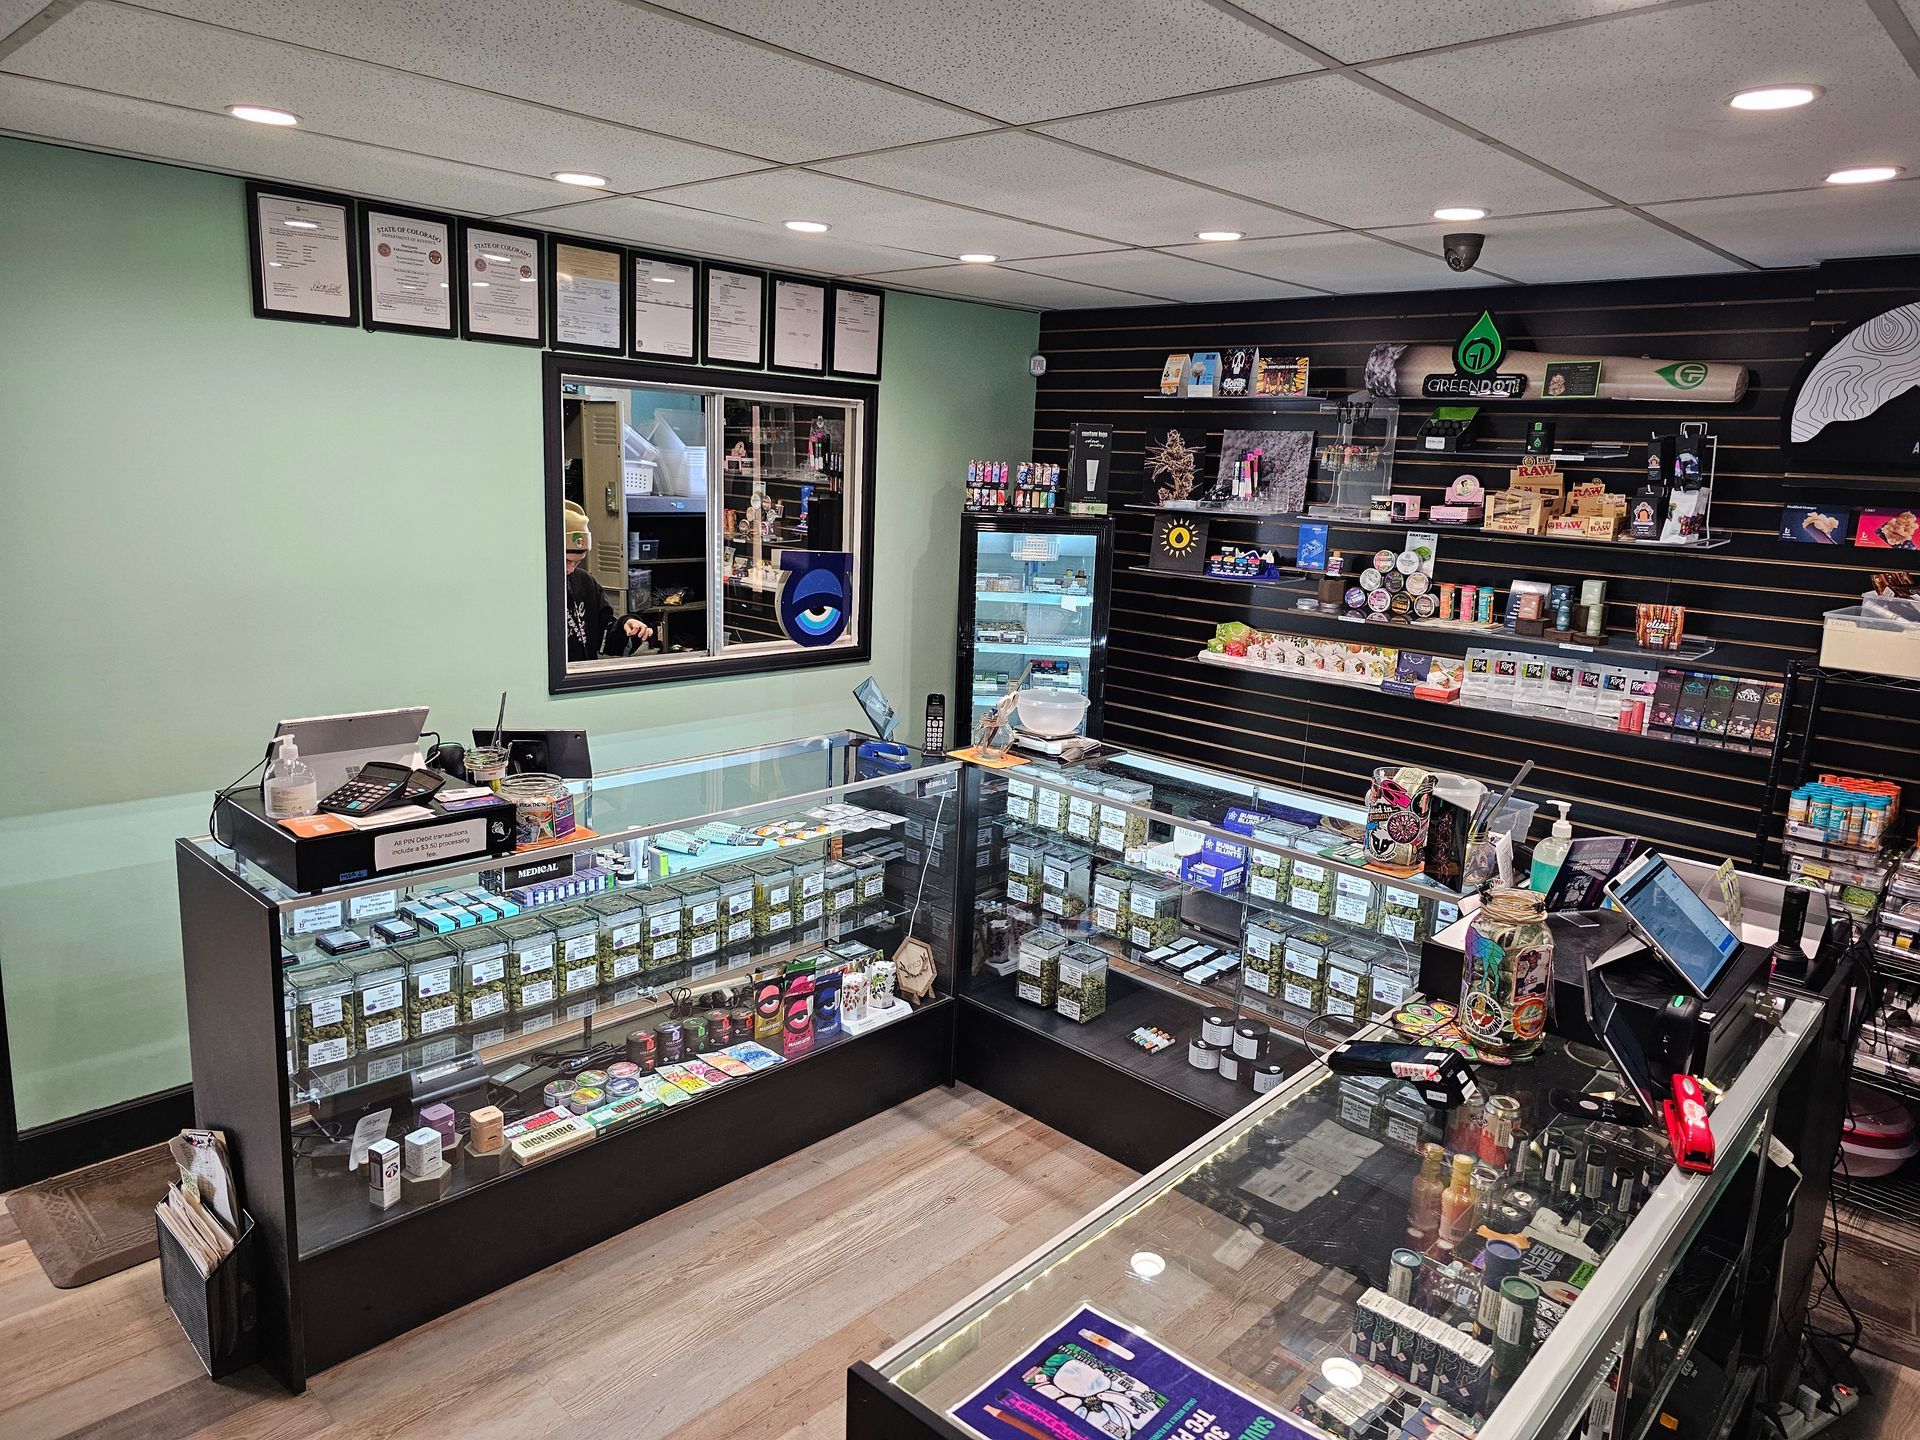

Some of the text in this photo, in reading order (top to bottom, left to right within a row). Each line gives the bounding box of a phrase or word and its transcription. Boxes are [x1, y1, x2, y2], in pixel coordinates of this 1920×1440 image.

[377, 226, 396, 234] STATE
[406, 228, 441, 243] COLORADO
[500, 244, 532, 258] COLORADO
[1518, 464, 1554, 477] RAW
[1573, 486, 1603, 498] RAW
[1555, 520, 1583, 530] RAW
[1590, 524, 1611, 532] RAW
[416, 835, 432, 843] Debit
[433, 830, 469, 840] transactions
[392, 846, 414, 855] include
[420, 842, 438, 851] $3.50
[438, 837, 470, 848] processing
[1215, 846, 1243, 858] BLUNTS
[1216, 841, 1243, 852] BUBBLE
[518, 863, 559, 879] MEDICAL
[520, 1122, 577, 1149] incredible
[1019, 1402, 1054, 1425] BUBBLE
[1184, 1408, 1216, 1434] TFC
